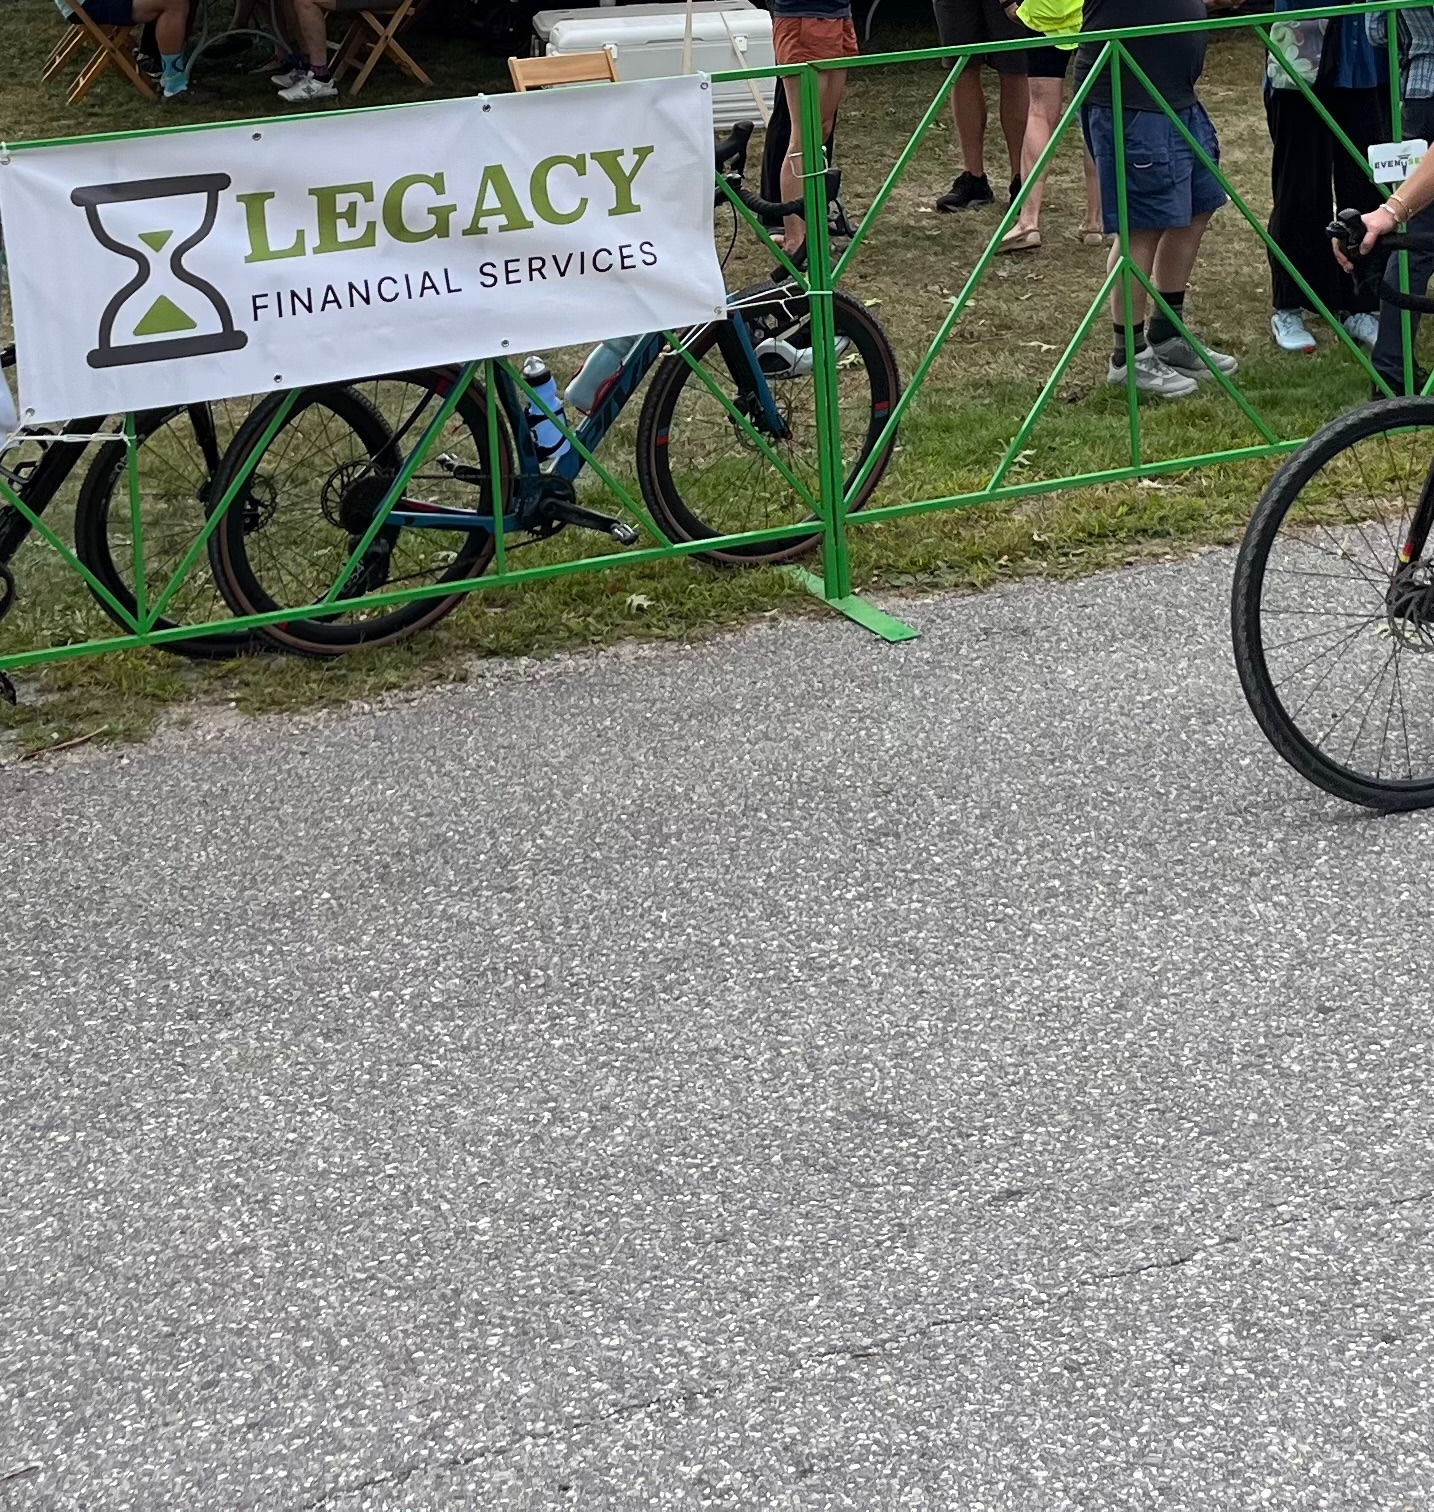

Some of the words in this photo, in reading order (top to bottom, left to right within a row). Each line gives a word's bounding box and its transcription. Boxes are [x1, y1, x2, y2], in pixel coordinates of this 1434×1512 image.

[236, 145, 655, 264] LEGACY
[251, 267, 463, 322] FINANCIAL
[478, 240, 659, 290] SERVICES
